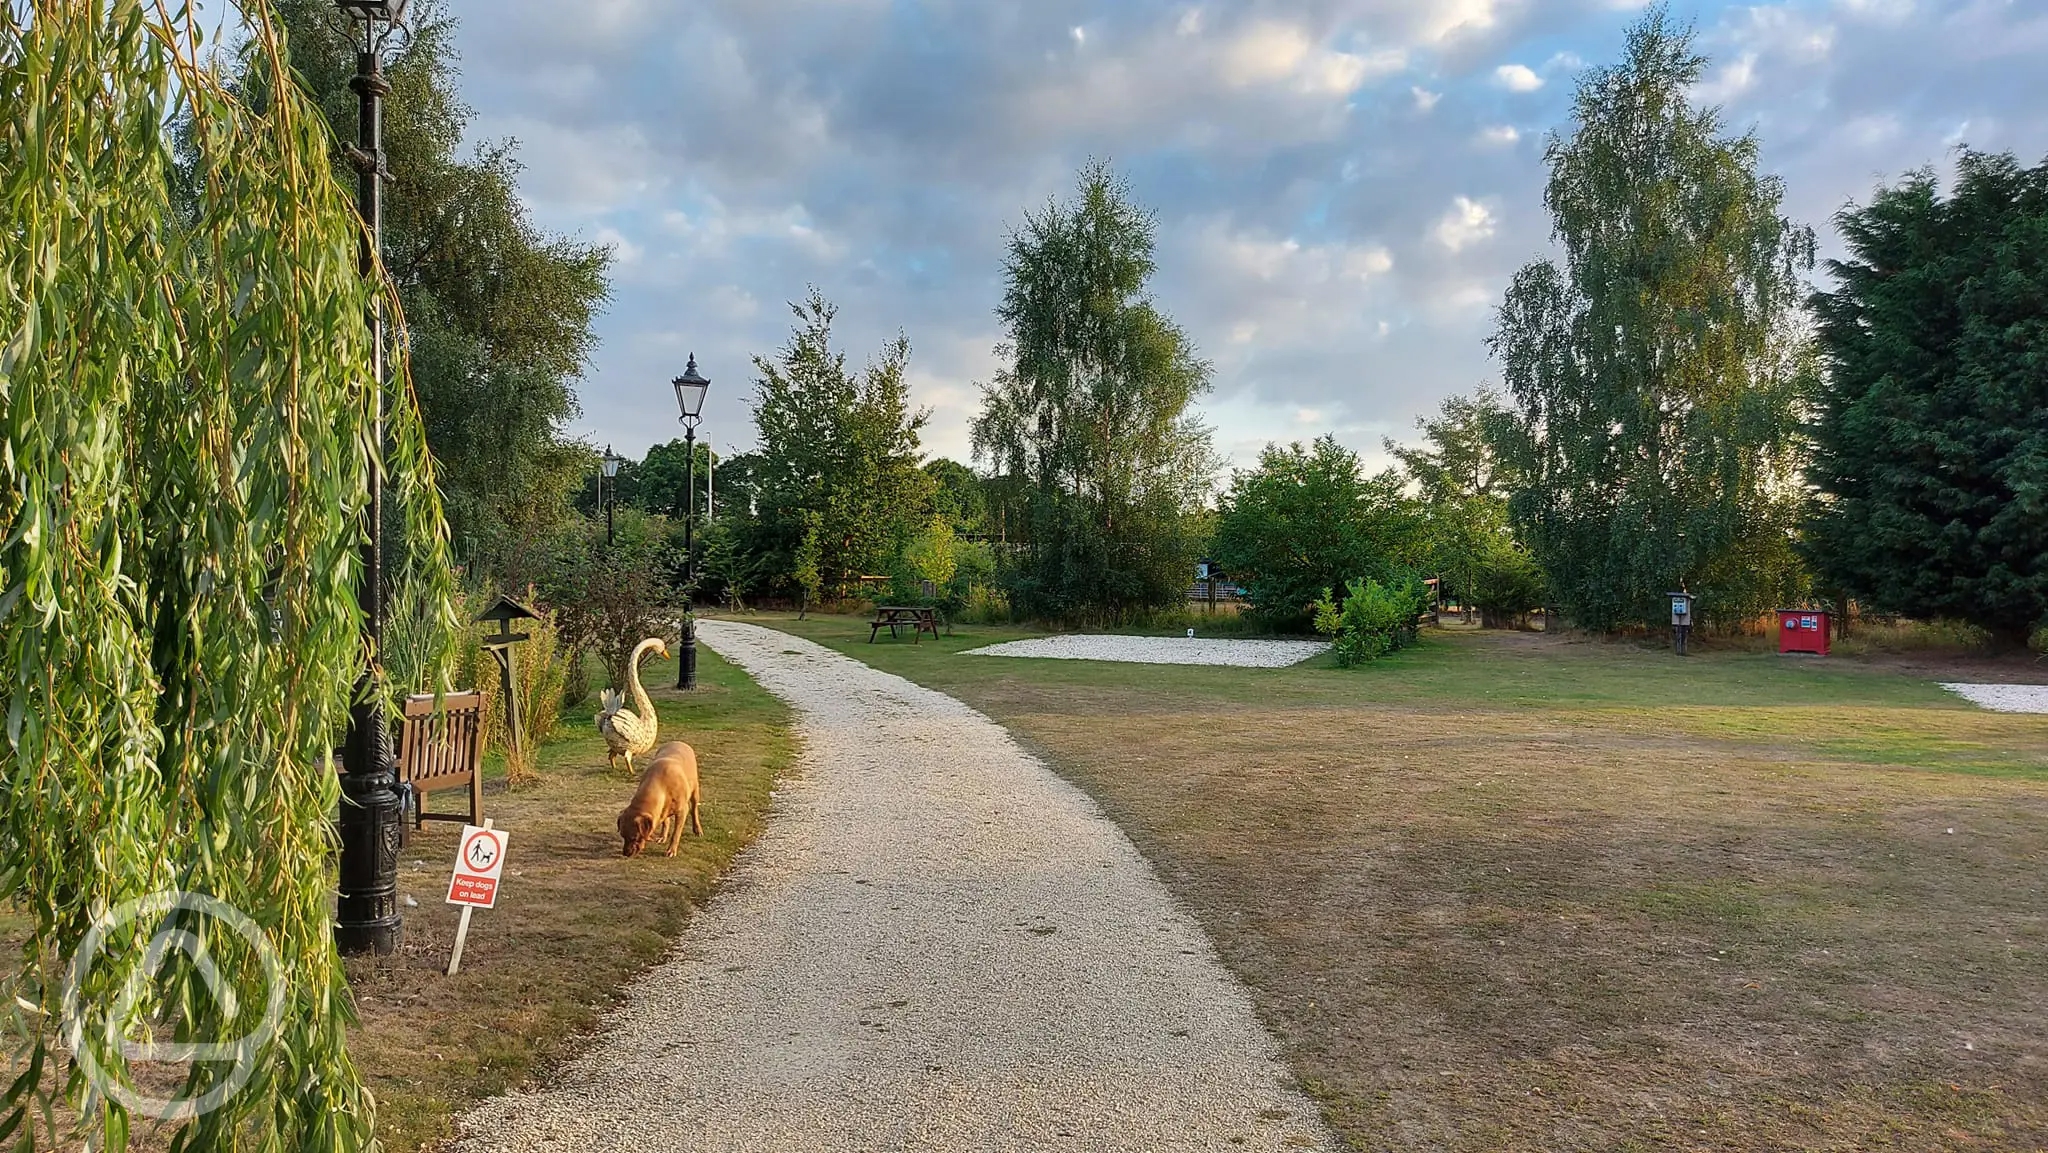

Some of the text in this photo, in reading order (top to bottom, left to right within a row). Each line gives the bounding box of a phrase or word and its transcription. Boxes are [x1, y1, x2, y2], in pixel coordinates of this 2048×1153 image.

[456, 878, 493, 890] Keep dogs
[470, 891, 486, 900] lead
